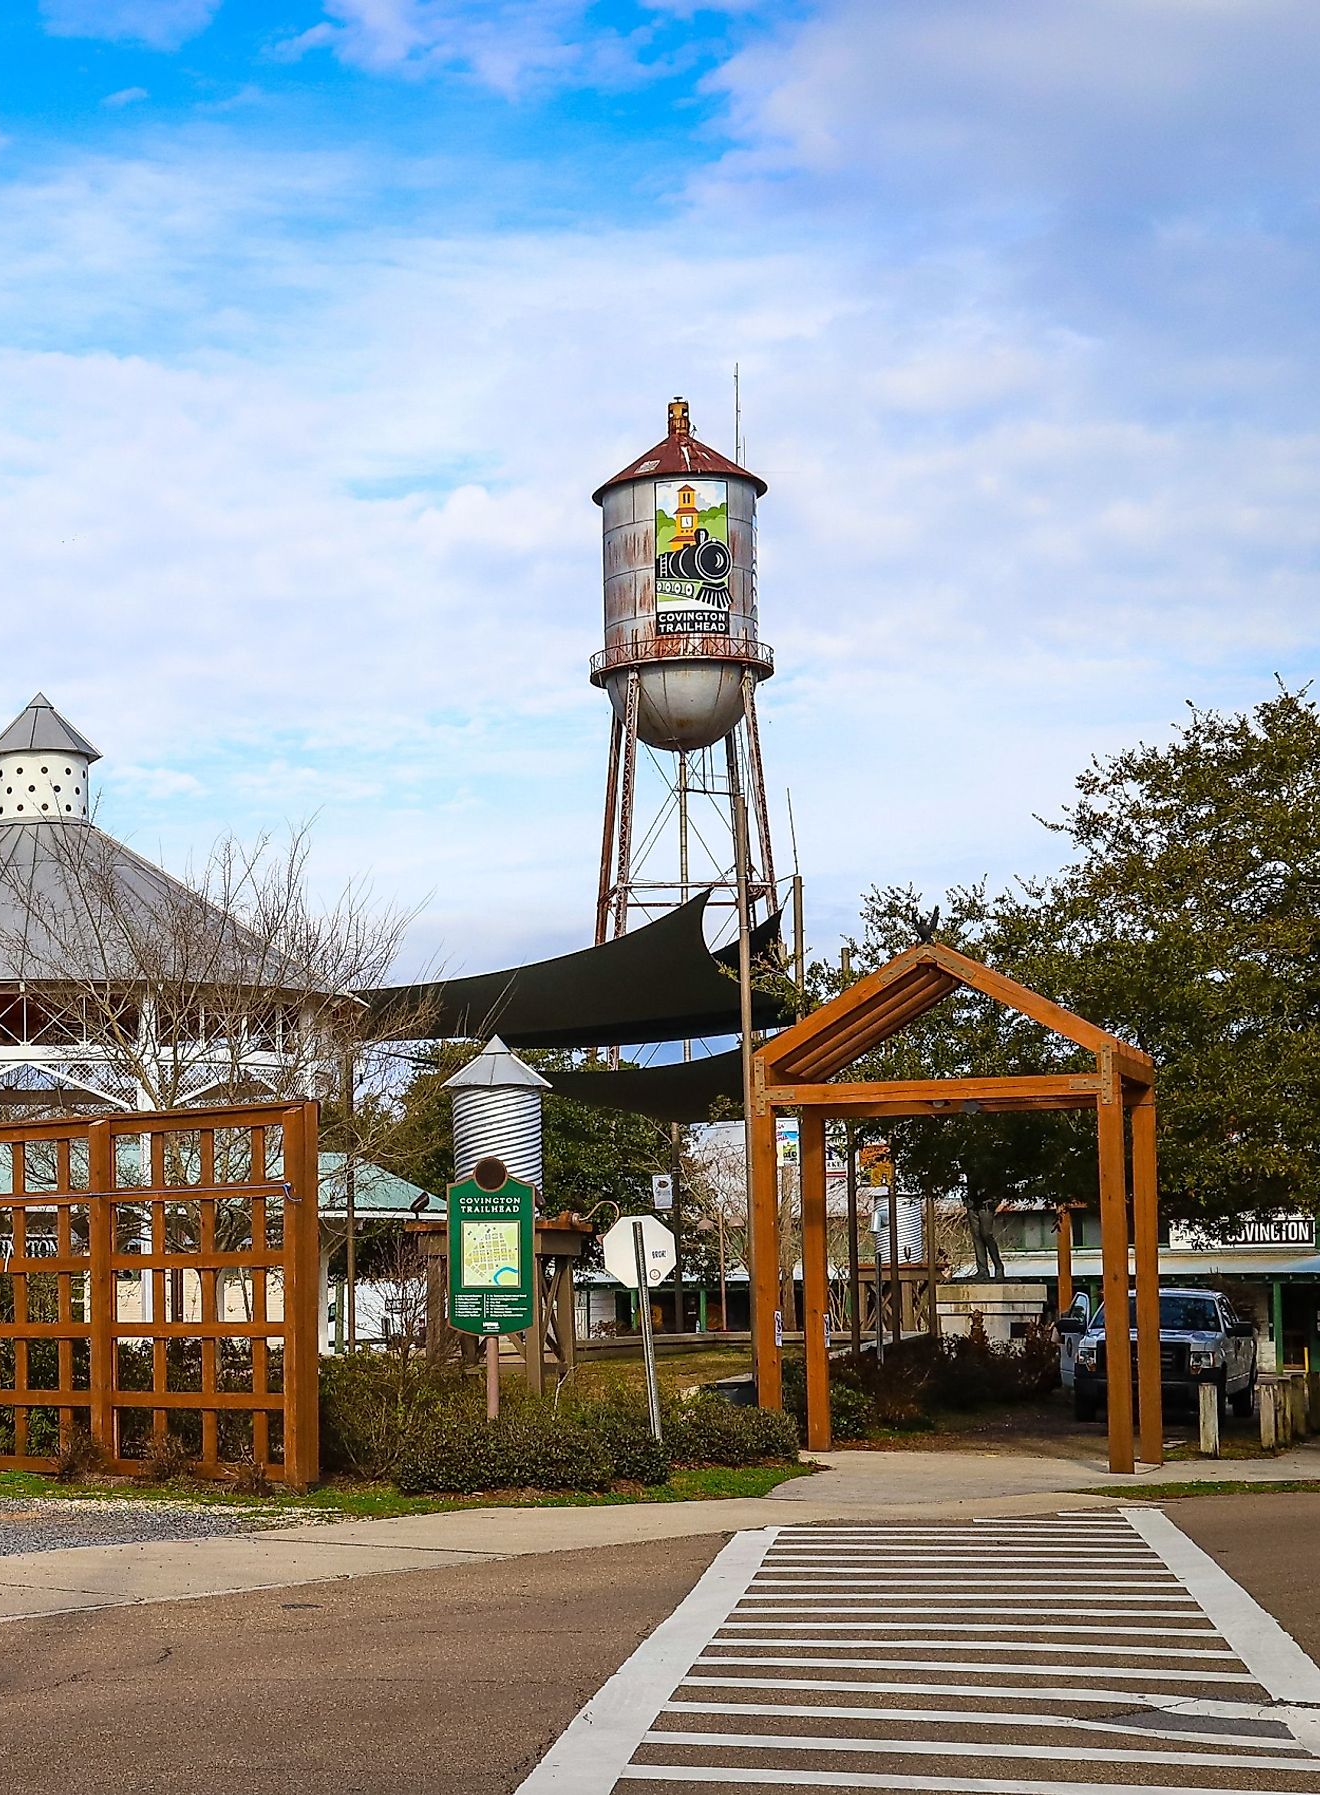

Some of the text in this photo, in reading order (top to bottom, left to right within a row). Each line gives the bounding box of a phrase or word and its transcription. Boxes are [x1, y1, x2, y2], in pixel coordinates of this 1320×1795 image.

[658, 612, 725, 622] COVINGTON
[658, 622, 726, 632] TRAILHEAD
[1227, 1222, 1309, 1242] OVINGTON
